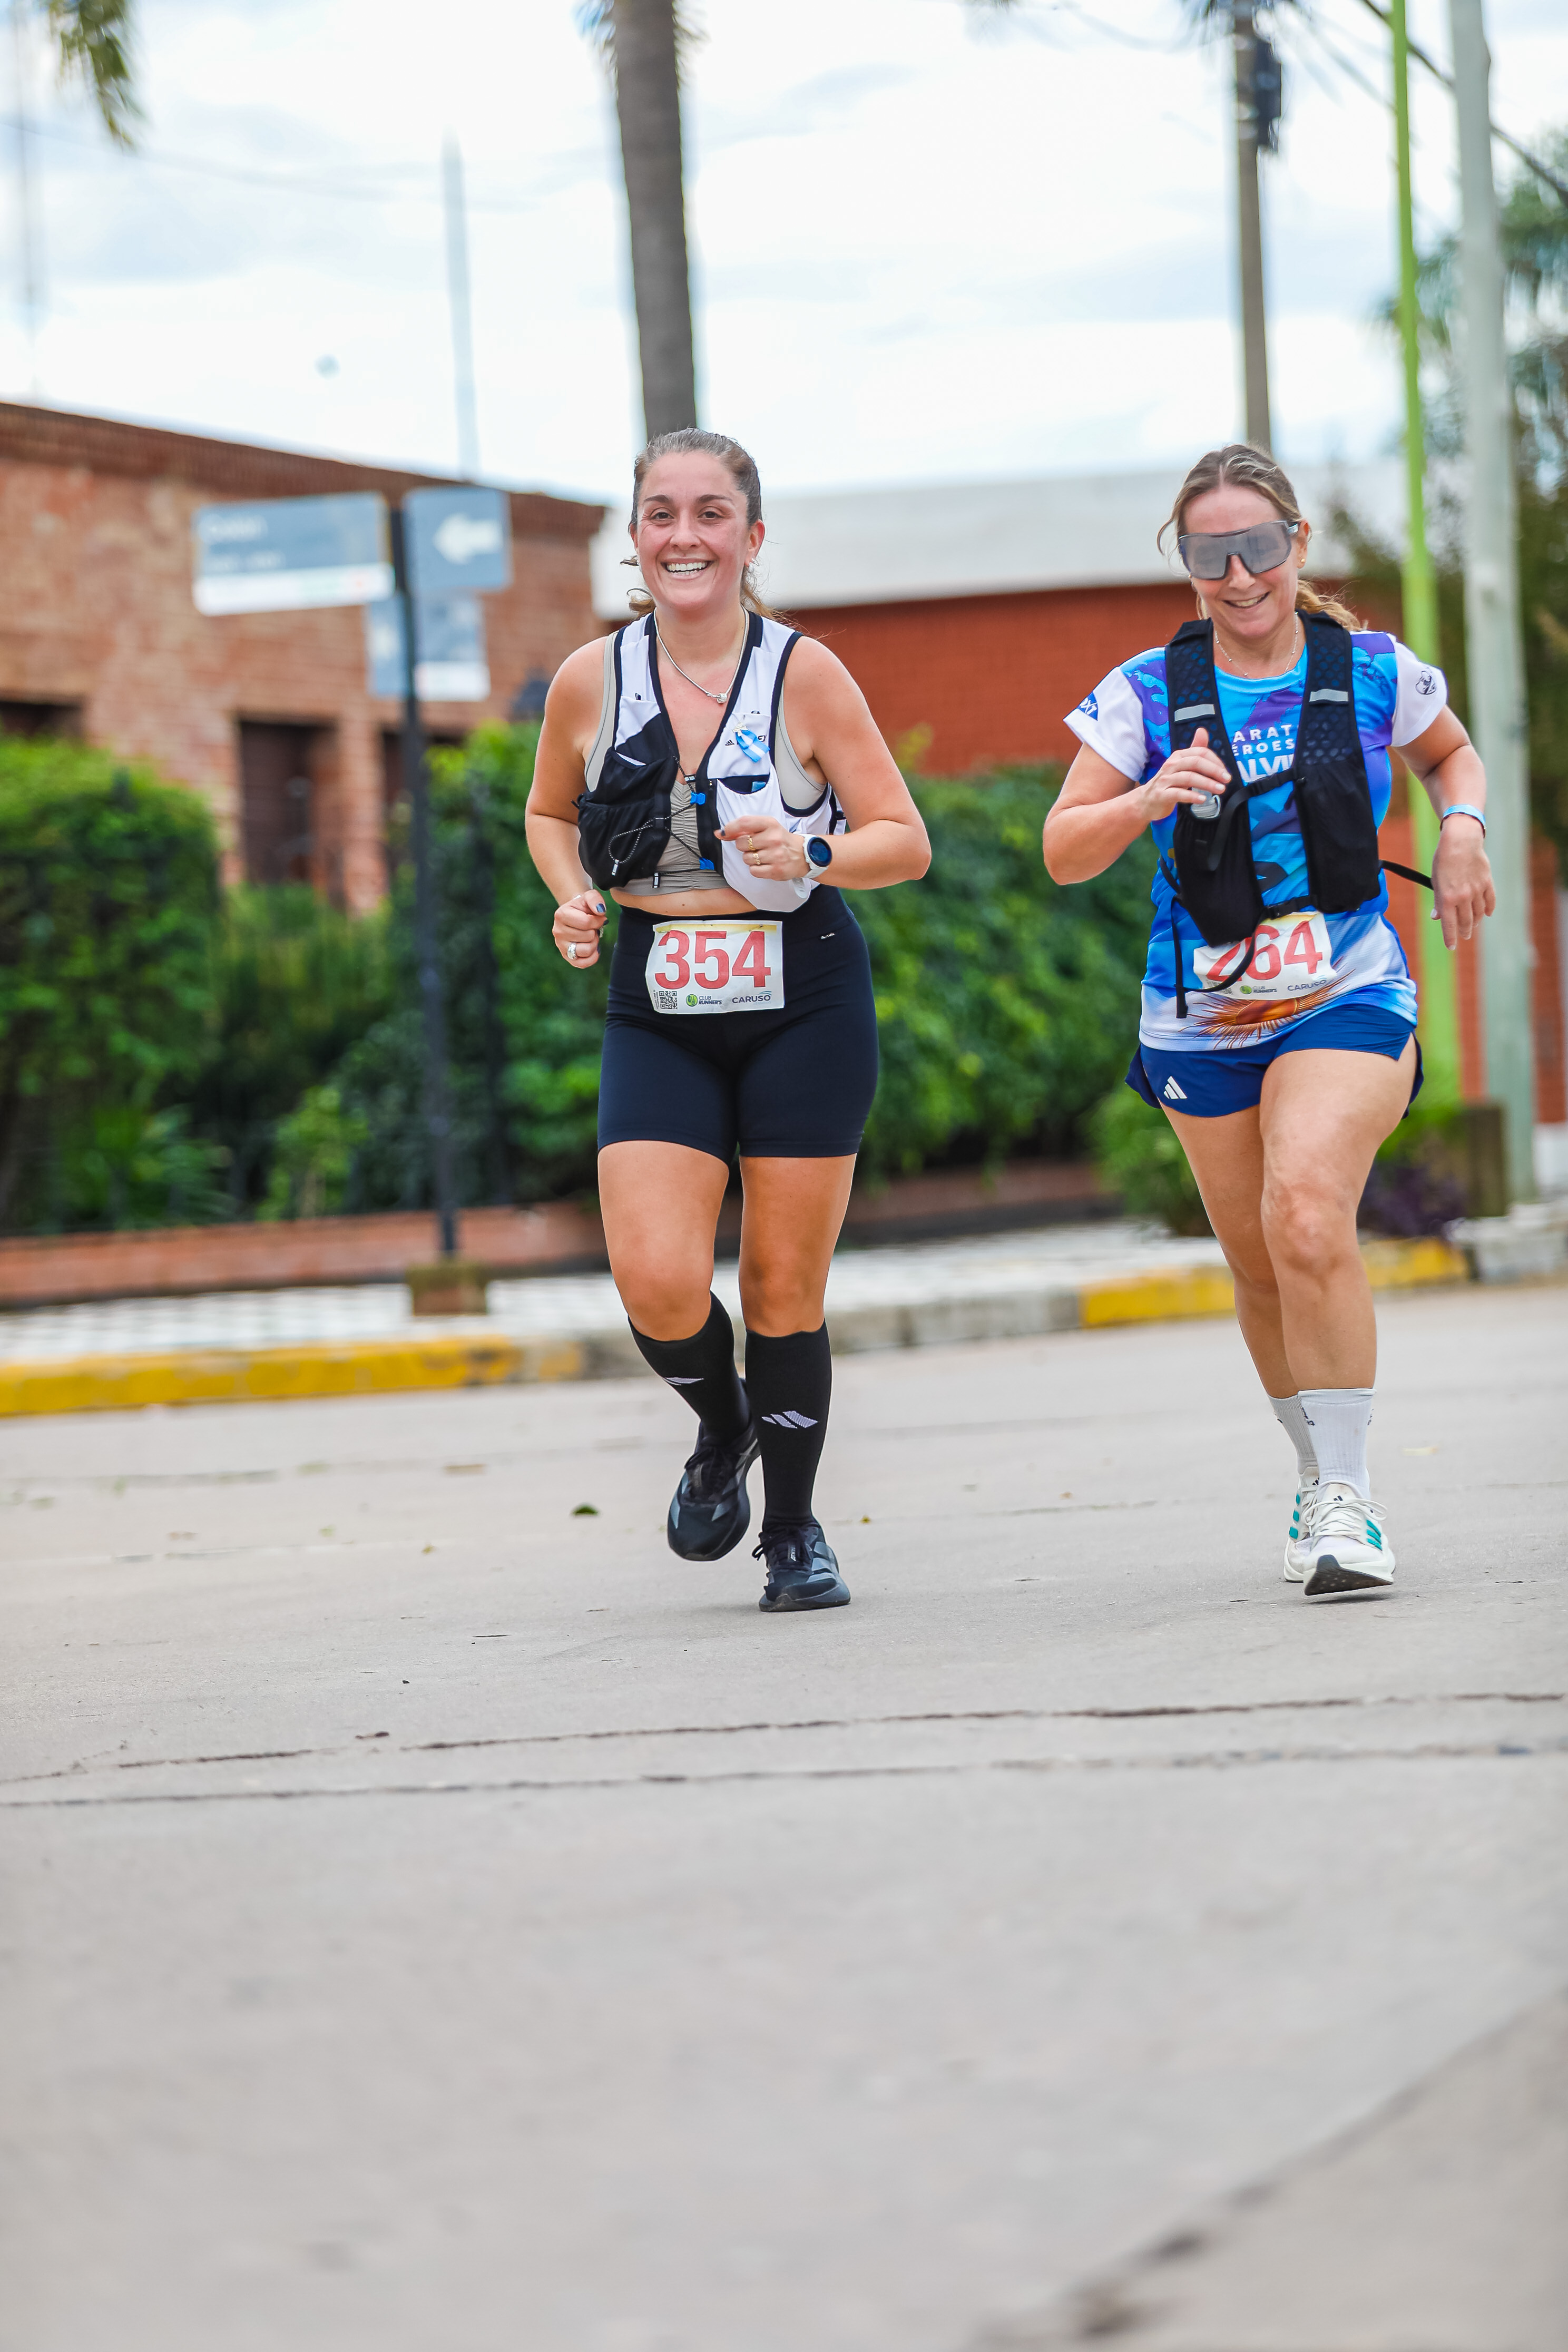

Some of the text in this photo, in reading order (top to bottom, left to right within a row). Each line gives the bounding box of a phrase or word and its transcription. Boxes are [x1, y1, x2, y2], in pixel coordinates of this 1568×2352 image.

[1232, 724, 1299, 743] ARAT
[1231, 739, 1295, 757] ÉROES
[654, 929, 771, 989] 354
[1206, 920, 1323, 981] 264
[1287, 979, 1327, 991] CARUSO
[732, 995, 771, 1004] CARUSO
